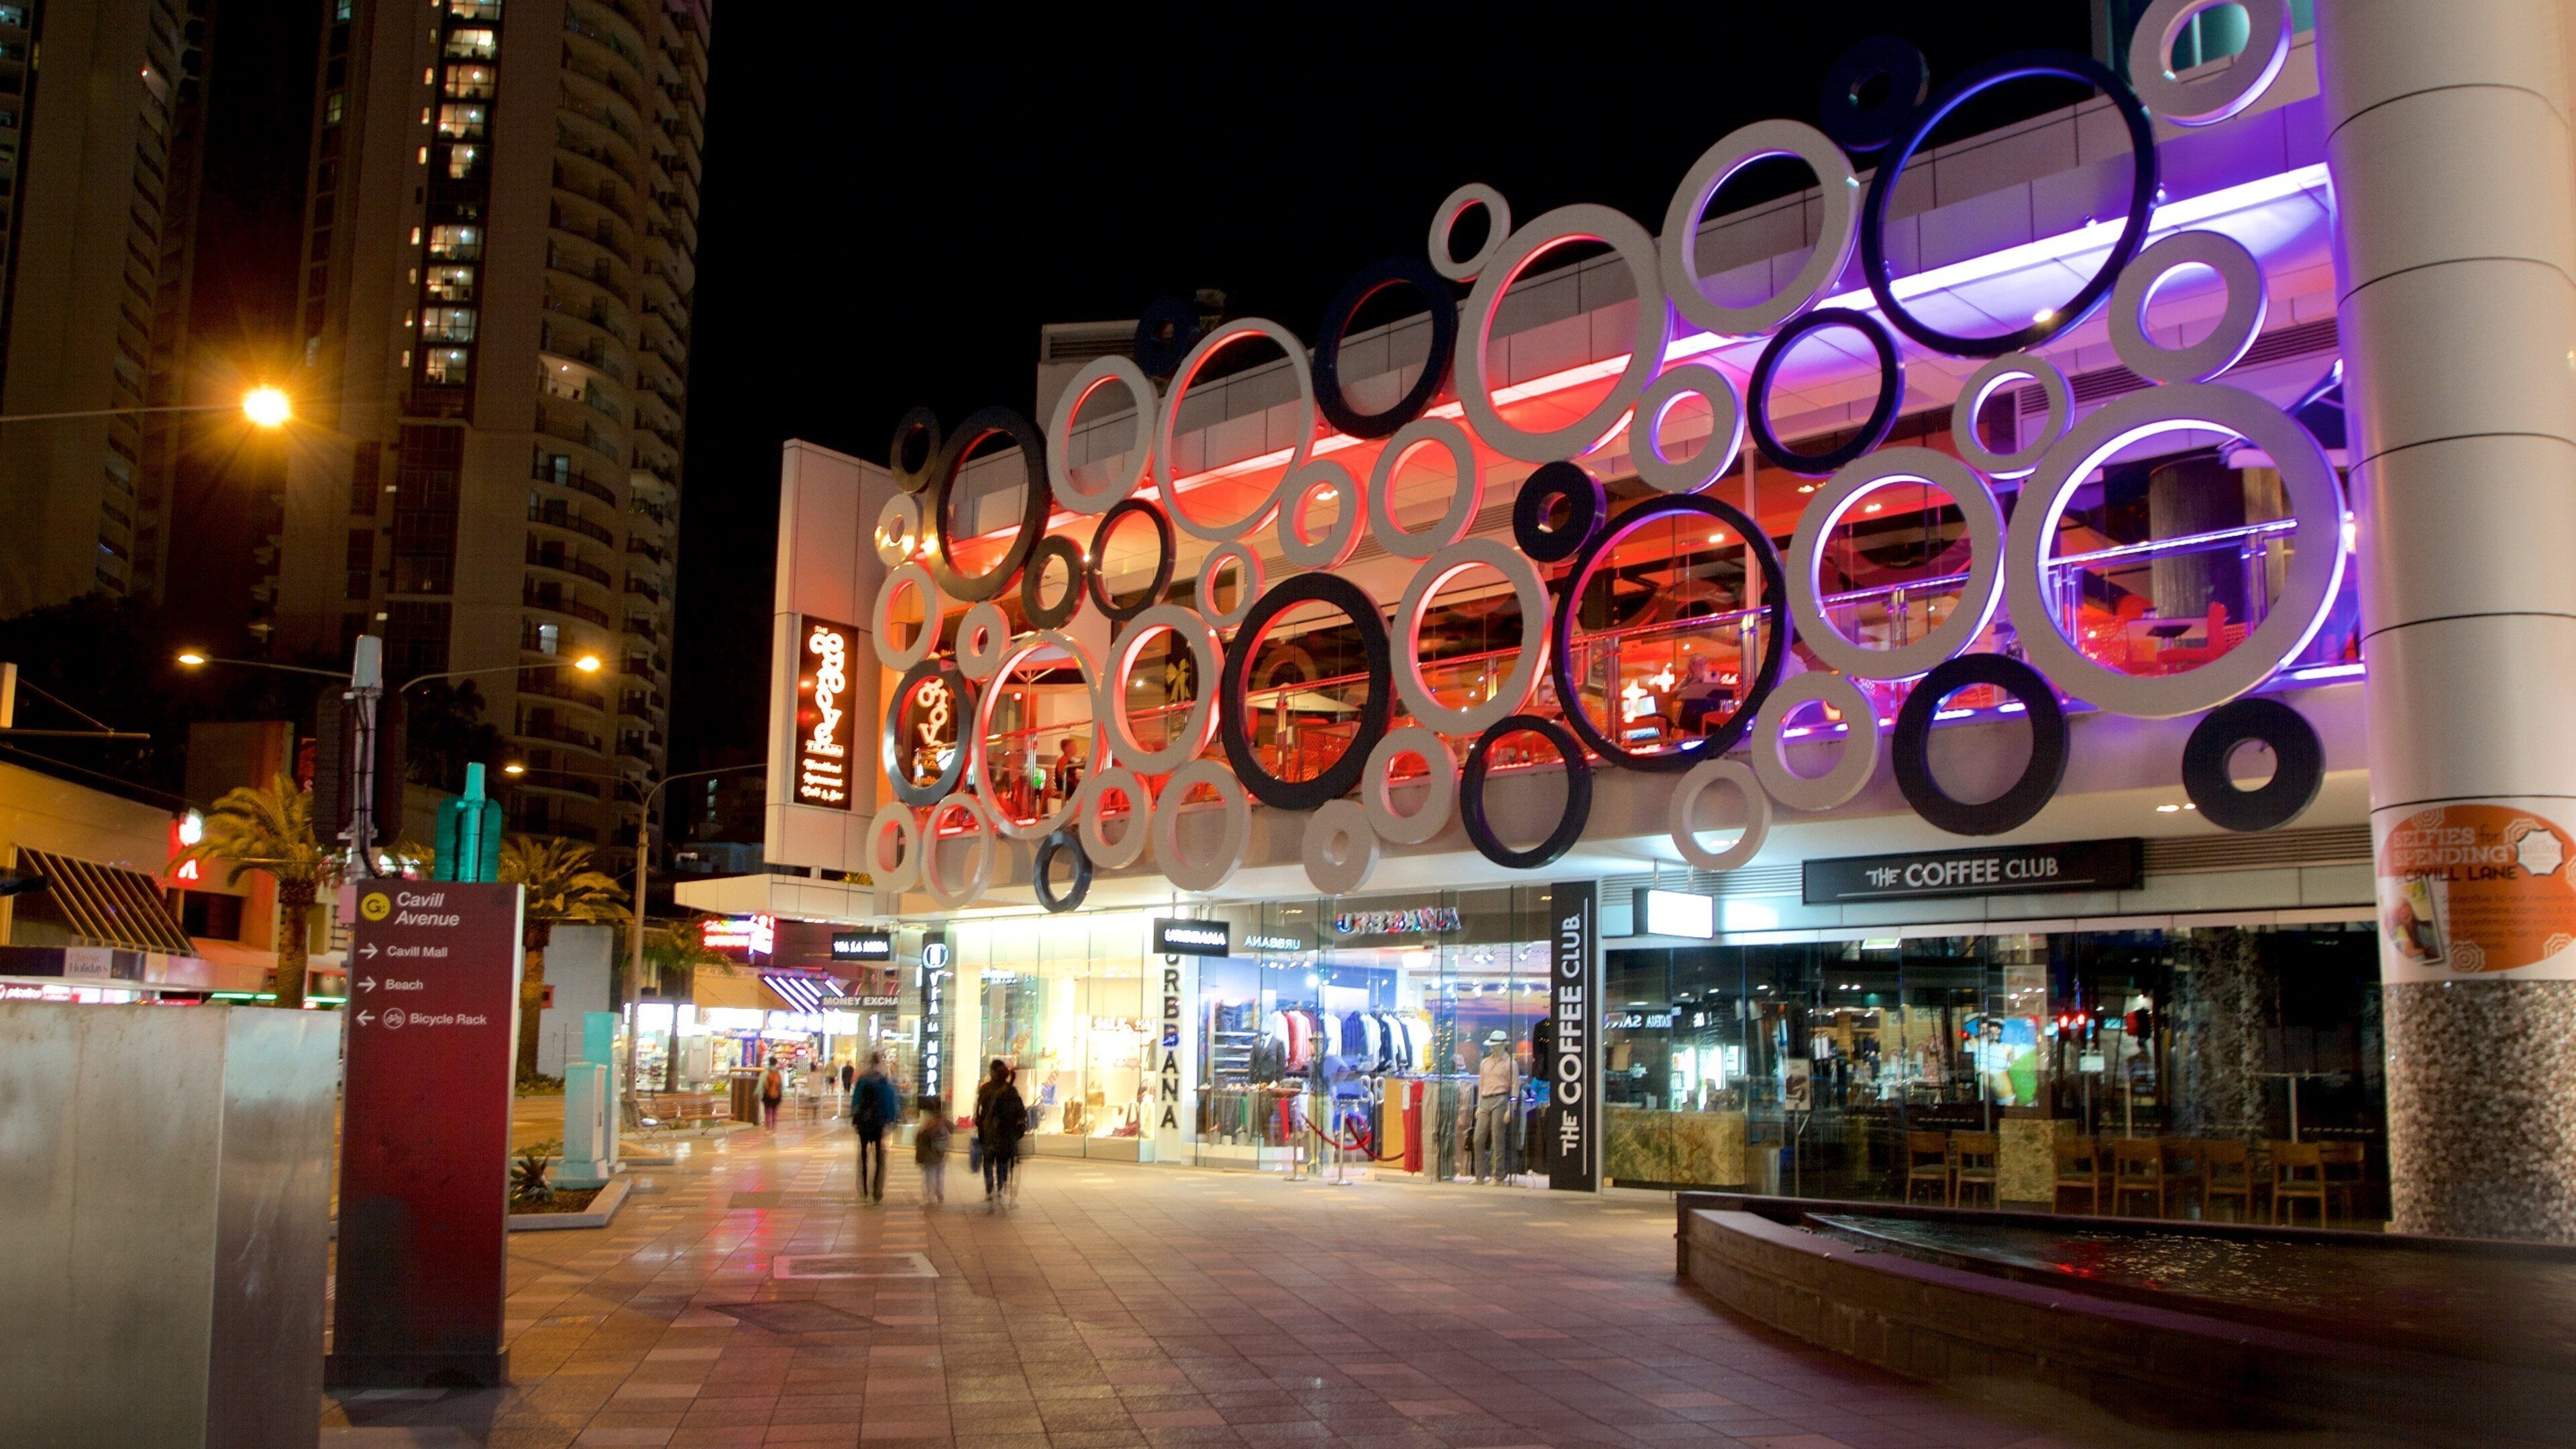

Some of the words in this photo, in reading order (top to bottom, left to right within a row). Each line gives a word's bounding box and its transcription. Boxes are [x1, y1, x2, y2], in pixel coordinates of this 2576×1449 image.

[2394, 845, 2508, 866] SPENDING
[1865, 867, 1901, 888] THE
[1905, 859, 2000, 888] COFFEE
[2006, 857, 2059, 879] CLUB
[396, 892, 444, 908] Cavill
[394, 910, 460, 926] Avenue
[387, 946, 420, 957] Cavill
[423, 947, 448, 957] Mall
[1561, 915, 1580, 979] CLUB
[385, 979, 423, 990] Beach
[824, 997, 861, 1006] MONEY
[411, 1013, 453, 1026] Bicycle
[457, 1014, 487, 1025] Rack
[1558, 985, 1582, 1105] COFFEE
[1562, 1110, 1579, 1157] THE
